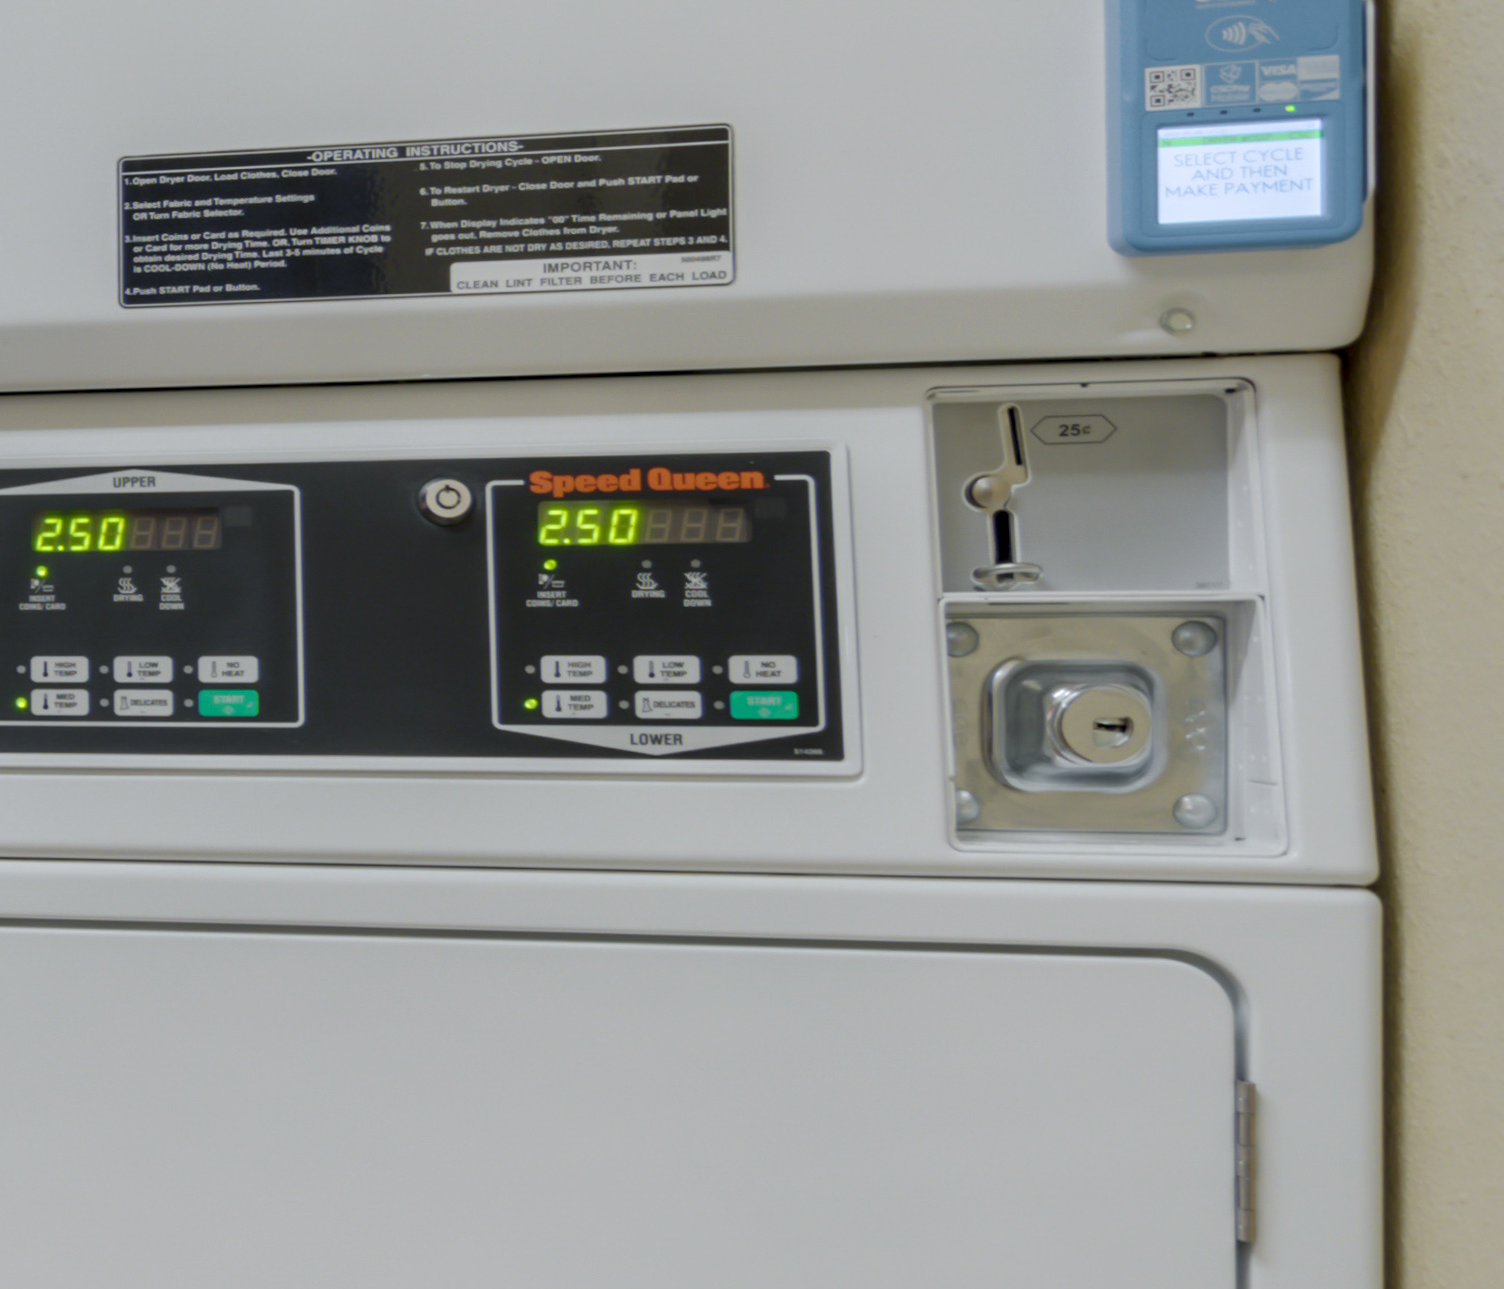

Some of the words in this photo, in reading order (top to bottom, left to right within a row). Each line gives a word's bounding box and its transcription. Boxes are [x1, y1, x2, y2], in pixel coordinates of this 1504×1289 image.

[1174, 151, 1237, 167] SELECT
[1243, 148, 1304, 162] CYCLE
[1191, 167, 1233, 181] AND
[1239, 165, 1288, 178] THEN
[1165, 183, 1217, 197] MAKE
[1223, 178, 1313, 195] PAYMENT
[543, 260, 637, 274] IMPORTANT:
[456, 280, 498, 291] CLEAN
[505, 278, 532, 288] LINT
[540, 276, 583, 287] FILTER
[590, 274, 641, 285] BEFORE
[649, 272, 684, 283] EACH
[691, 270, 727, 281] LOAD
[1058, 424, 1091, 437] 25¢
[113, 476, 156, 488] UPPER
[529, 469, 641, 498] Speed
[647, 467, 764, 491] Queen
[539, 508, 638, 545] 2.50
[35, 516, 126, 551] 2.50
[567, 661, 591, 669] HIGH
[662, 661, 684, 669] LOW
[760, 661, 776, 669] NO
[566, 670, 593, 678] TEMP
[660, 670, 687, 678] TEMP
[755, 670, 781, 678] HEAT
[568, 703, 594, 711] TEMP
[653, 701, 695, 709] DELICATES
[747, 697, 782, 706] START
[630, 733, 682, 746] LOWER
